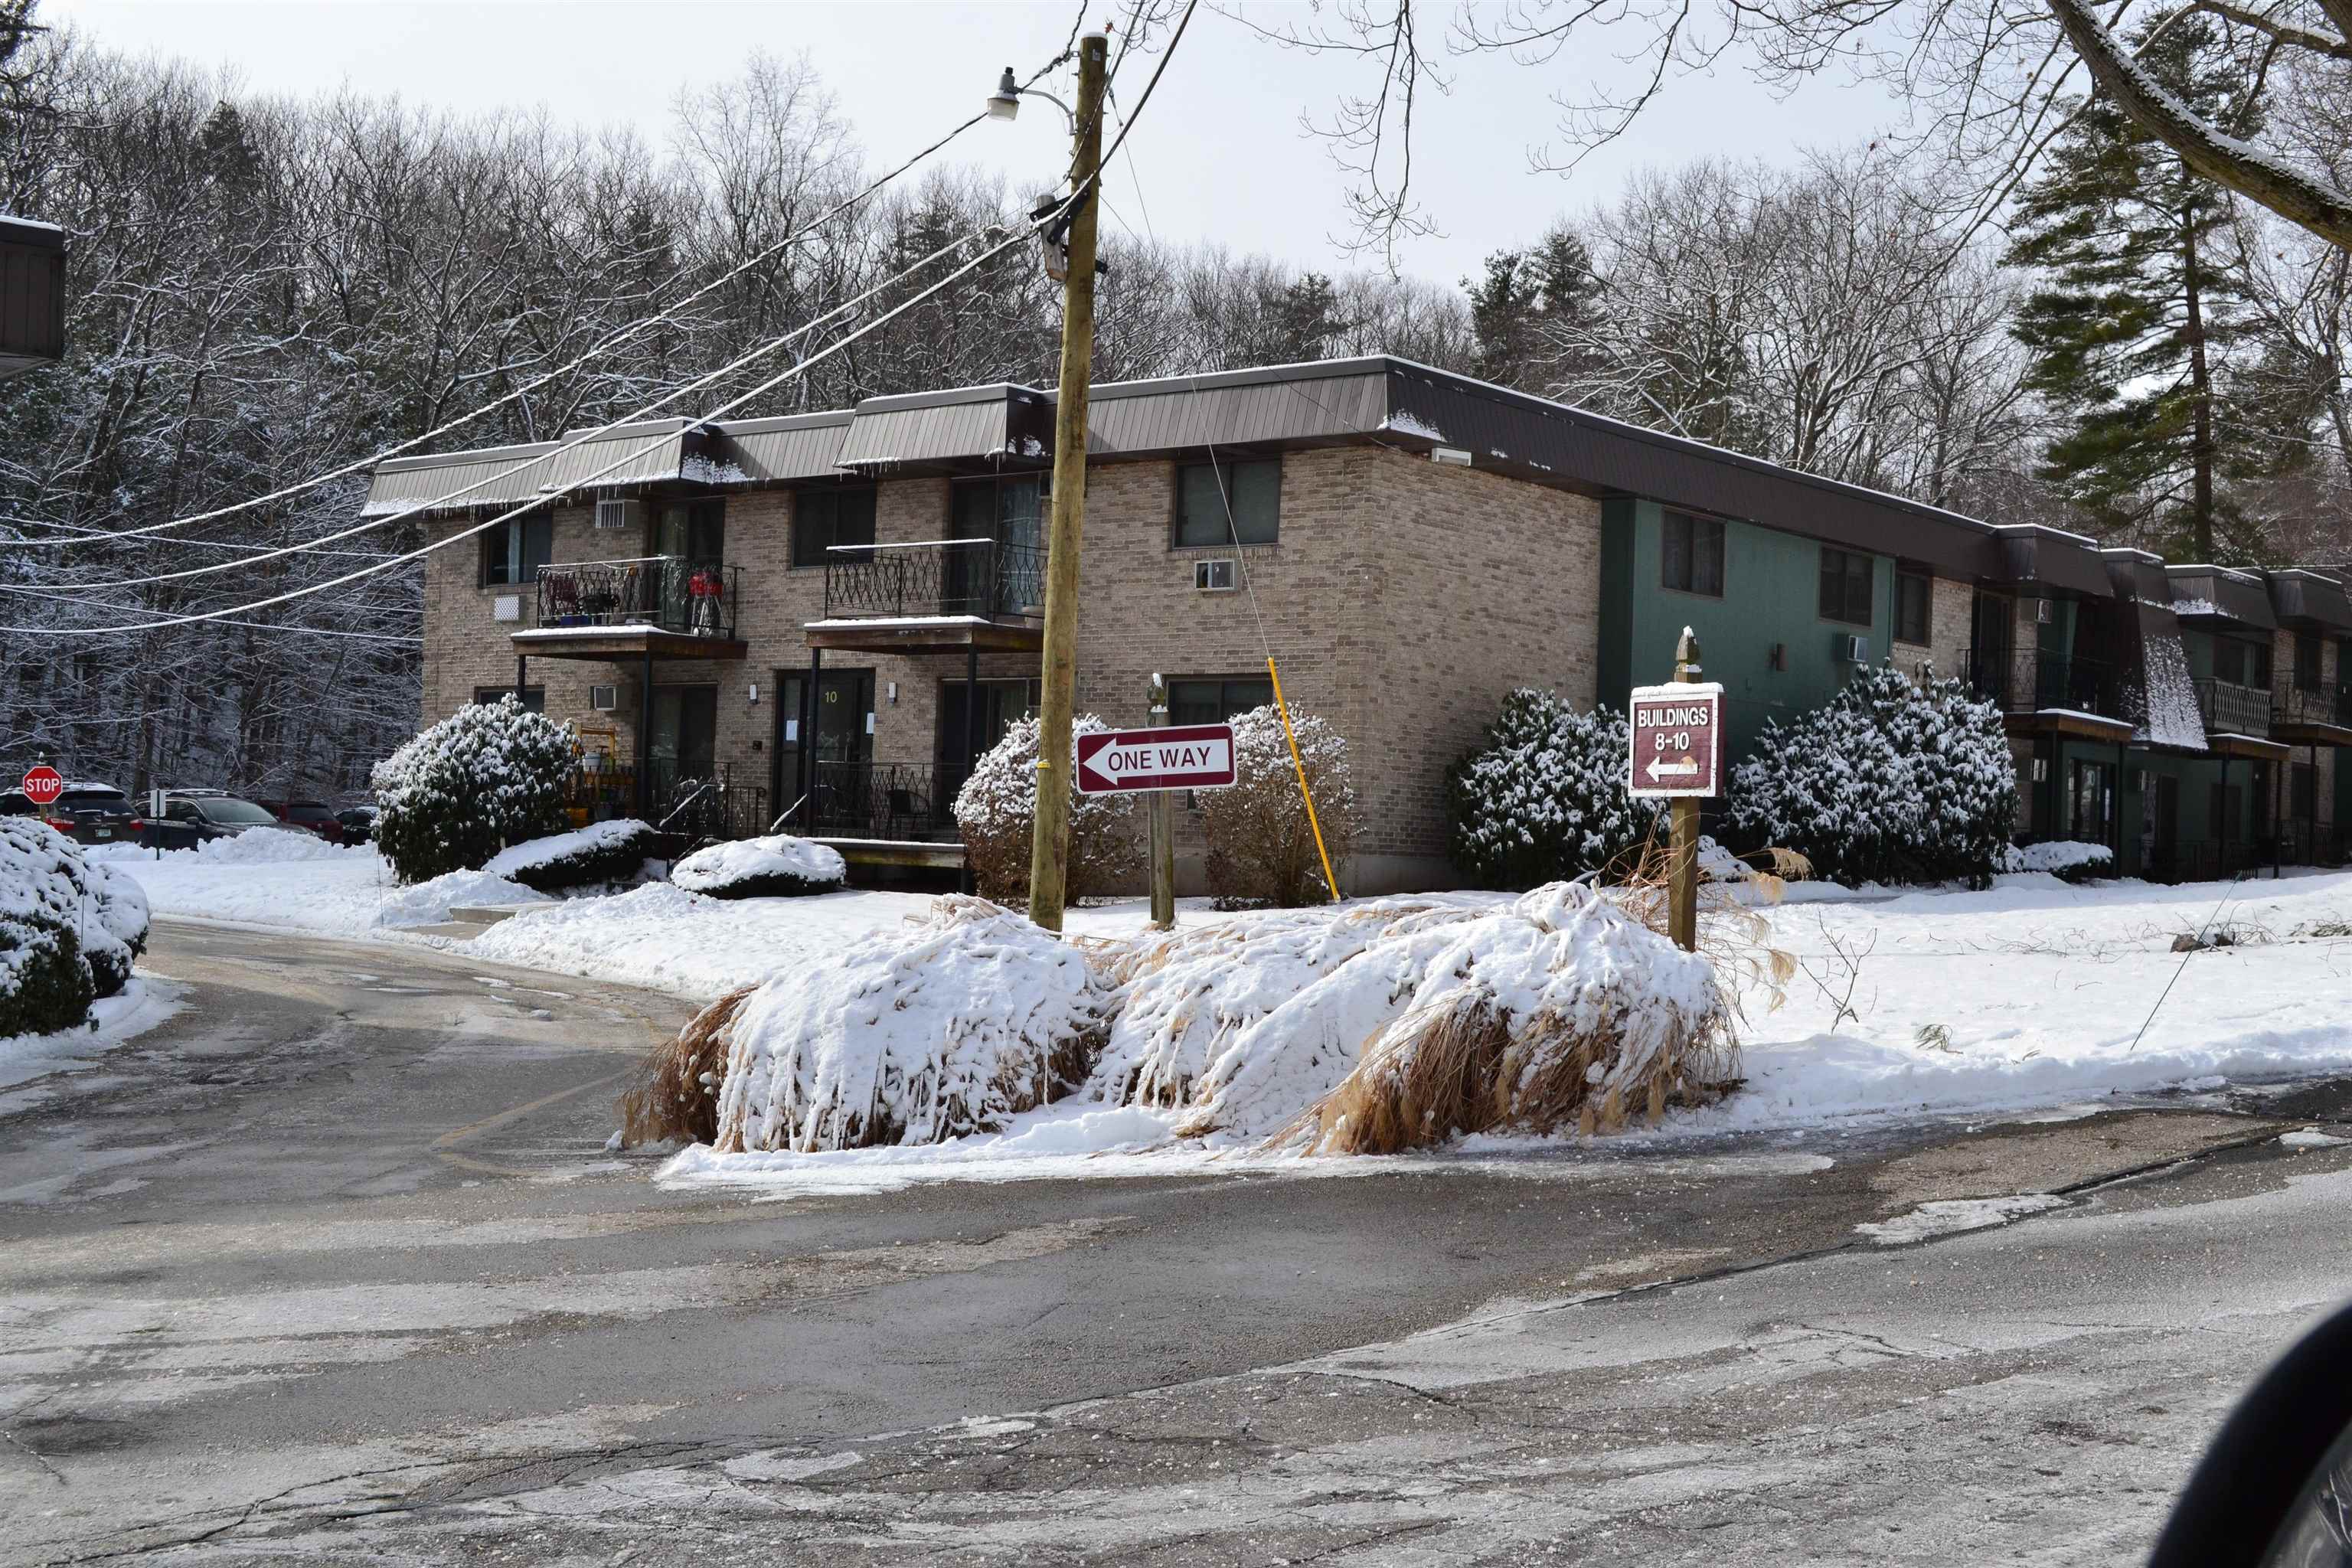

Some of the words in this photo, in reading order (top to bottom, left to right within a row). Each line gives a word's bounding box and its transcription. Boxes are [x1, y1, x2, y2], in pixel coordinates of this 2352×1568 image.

[825, 691, 838, 703] 10
[1638, 707, 1709, 728] BUILDINGS
[1655, 731, 1690, 751] 8-10
[1108, 750, 1152, 772] ONE
[1158, 746, 1211, 768] WAY
[26, 778, 60, 792] STOP
